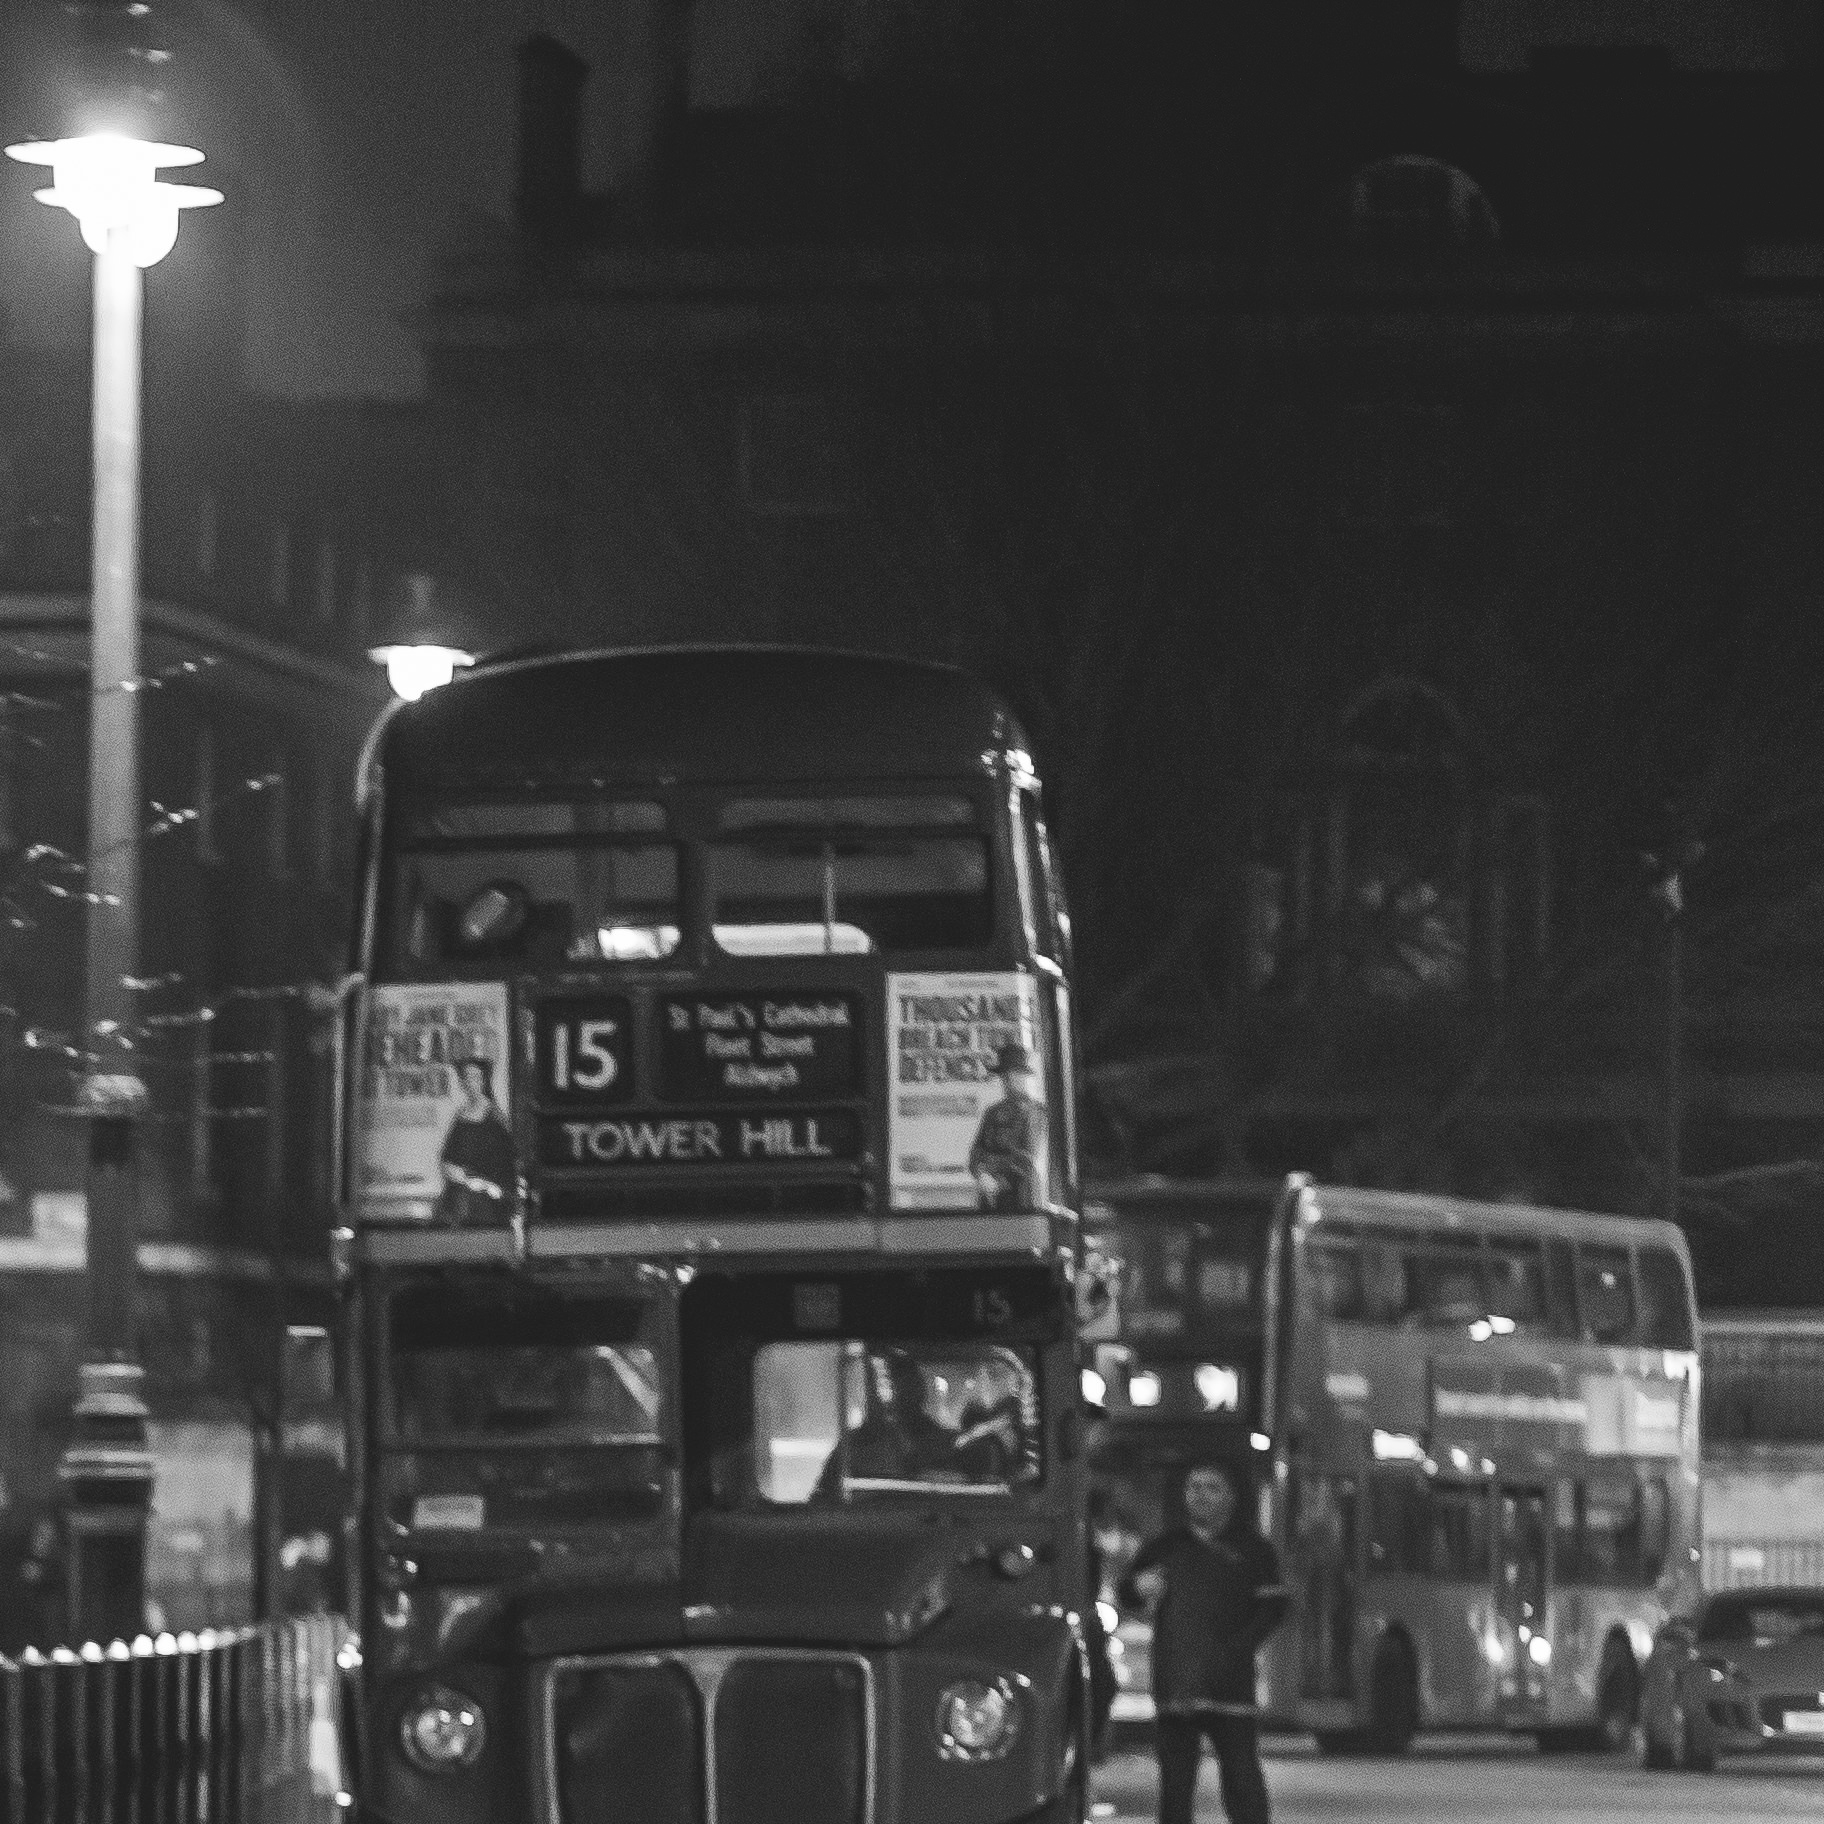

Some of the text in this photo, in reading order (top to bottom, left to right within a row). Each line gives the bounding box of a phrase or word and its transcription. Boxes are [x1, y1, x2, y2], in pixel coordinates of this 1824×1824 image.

[554, 1019, 617, 1090] 15
[562, 1117, 833, 1159] TOWER HILL
[973, 1289, 1013, 1324] 15
